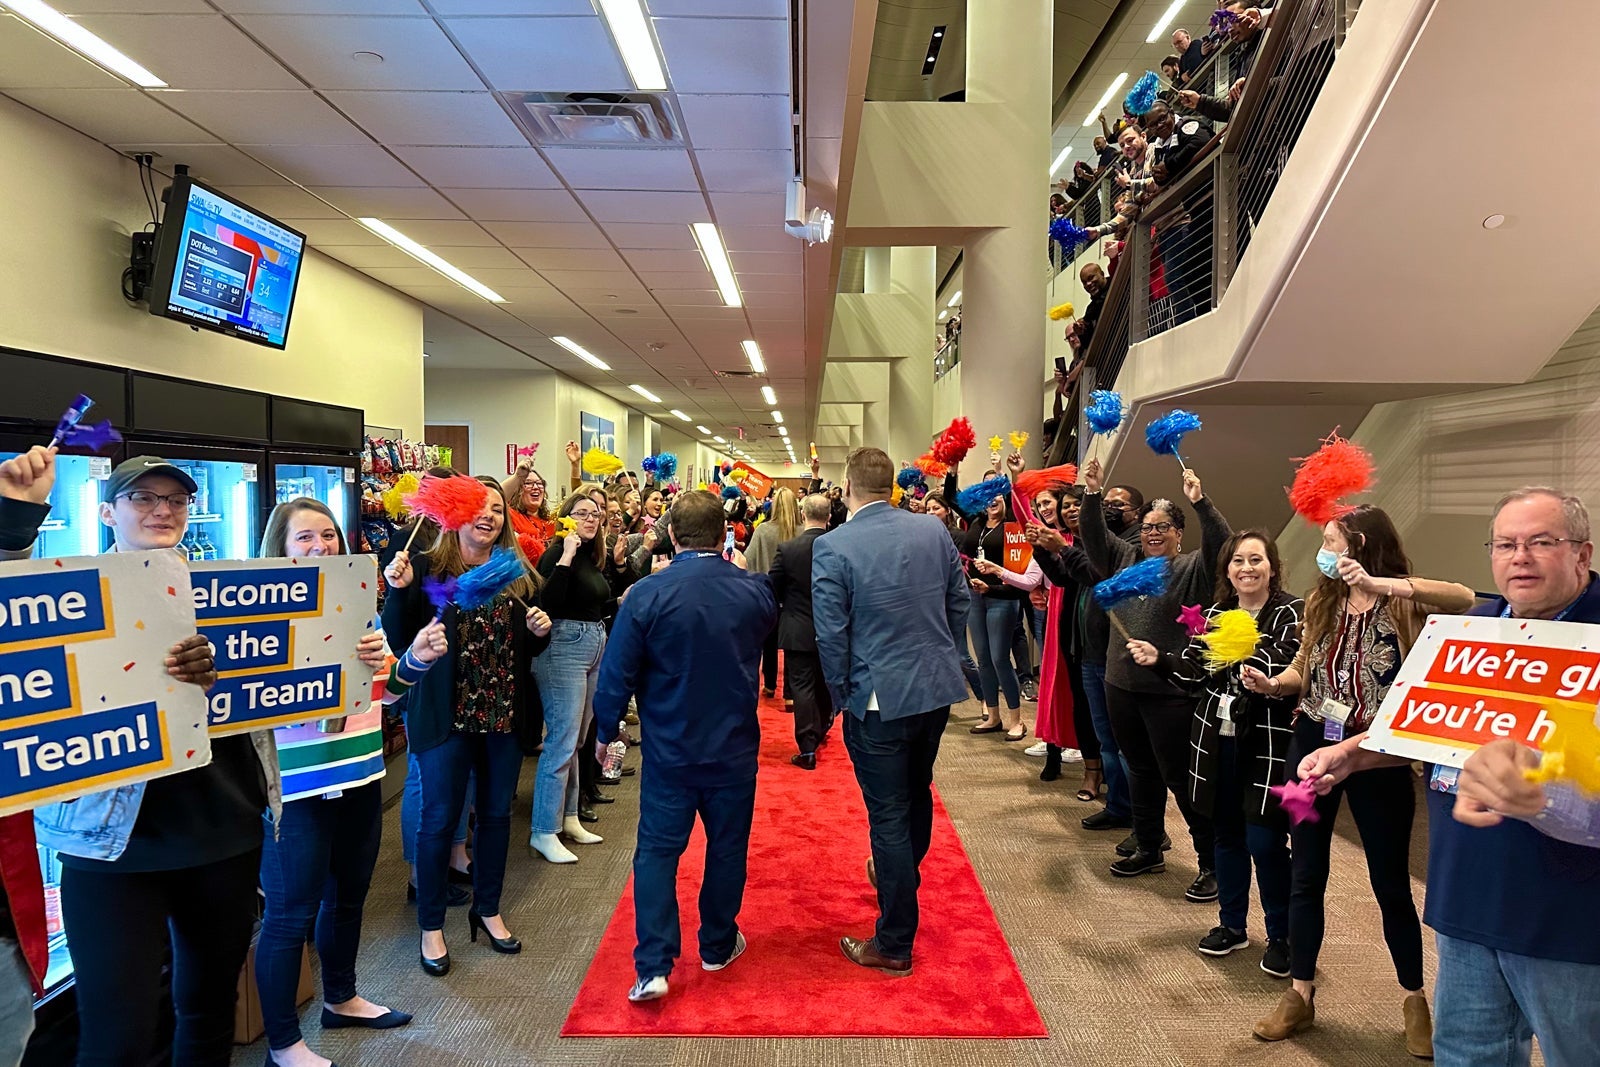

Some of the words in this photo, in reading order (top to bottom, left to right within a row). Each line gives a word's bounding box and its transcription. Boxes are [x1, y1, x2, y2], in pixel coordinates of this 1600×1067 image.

[214, 204, 222, 216] TV
[190, 238, 203, 249] DOT
[202, 243, 218, 255] Results
[258, 282, 270, 298] 34
[1010, 549, 1021, 562] FLY
[226, 629, 279, 660] the
[1443, 645, 1548, 683] We're
[241, 672, 334, 710] Team!
[1399, 699, 1517, 738] you're
[2, 713, 151, 778] Team!
